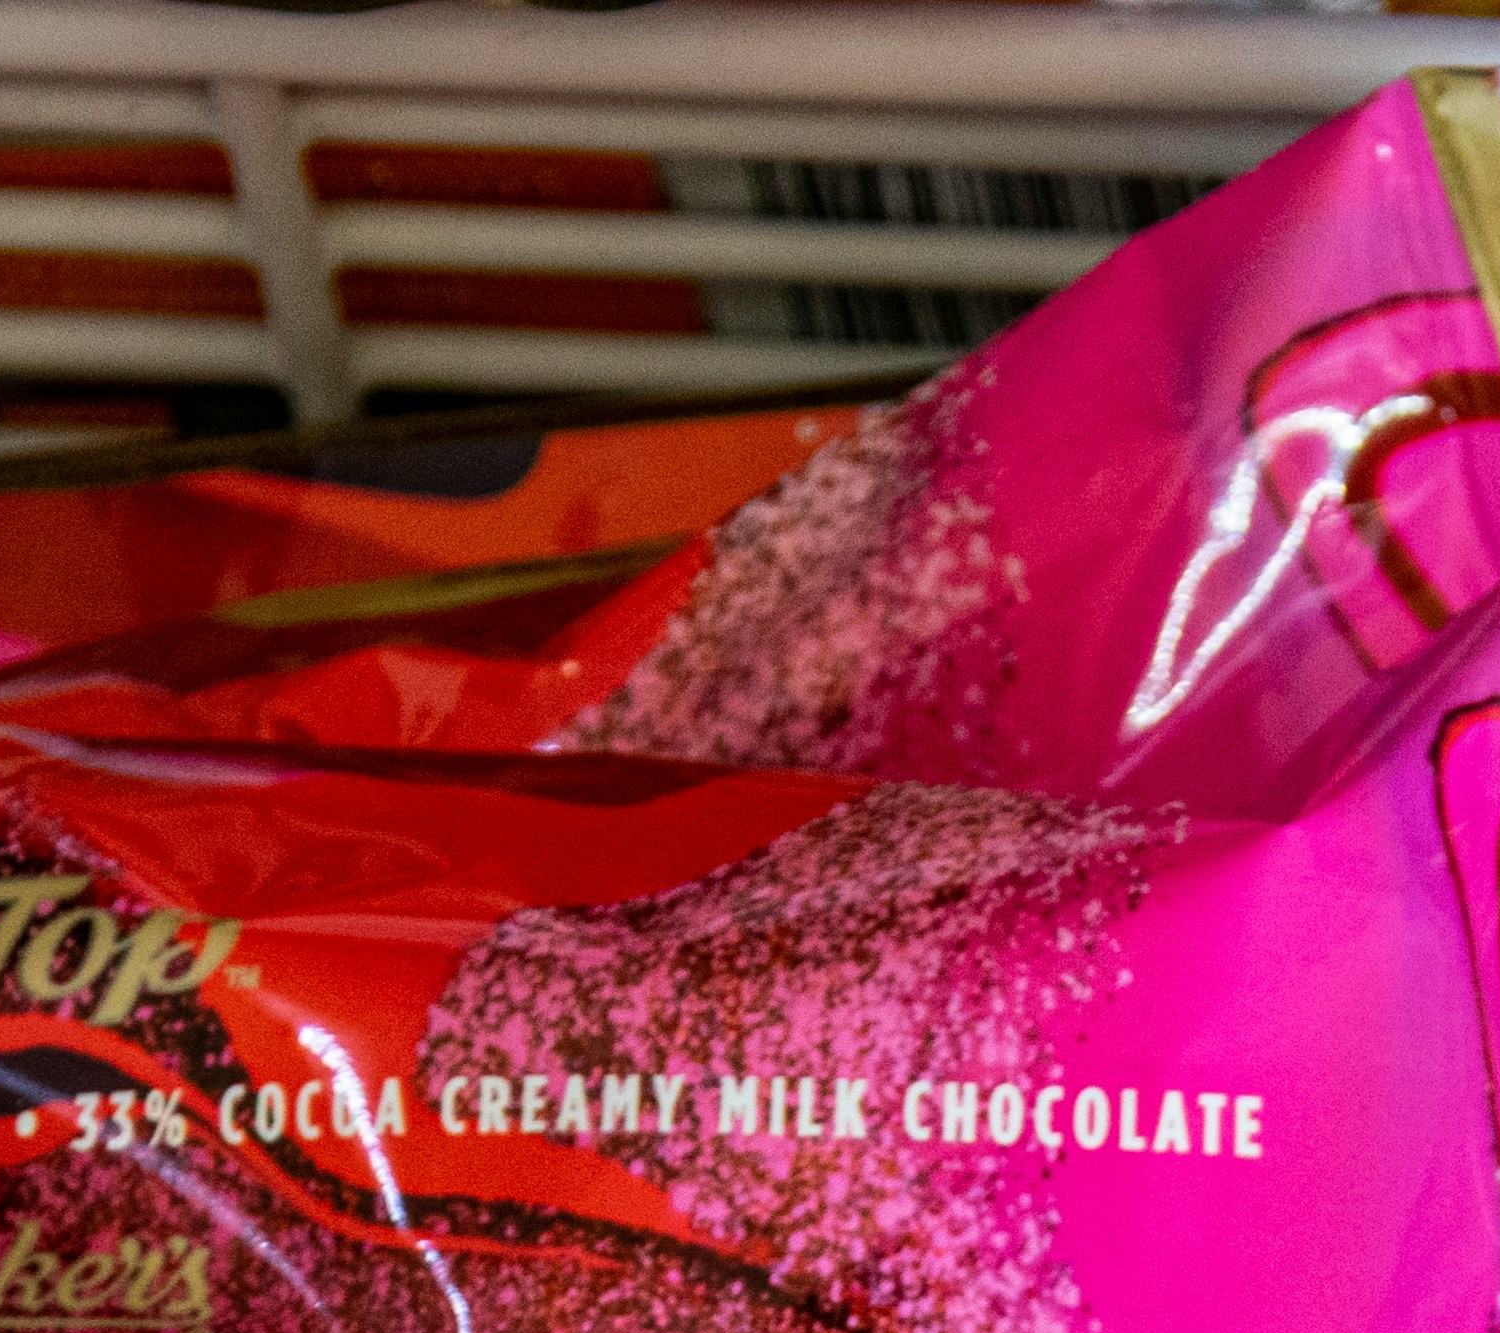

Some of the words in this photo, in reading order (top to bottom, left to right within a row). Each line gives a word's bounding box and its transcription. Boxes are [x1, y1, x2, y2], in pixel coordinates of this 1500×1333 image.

[70, 1091, 187, 1152] 33%
[219, 1076, 408, 1146] COCOA
[440, 1073, 686, 1137] CREAMY
[717, 1077, 868, 1141] MILK
[903, 1080, 1264, 1160] CHOCOLATE
